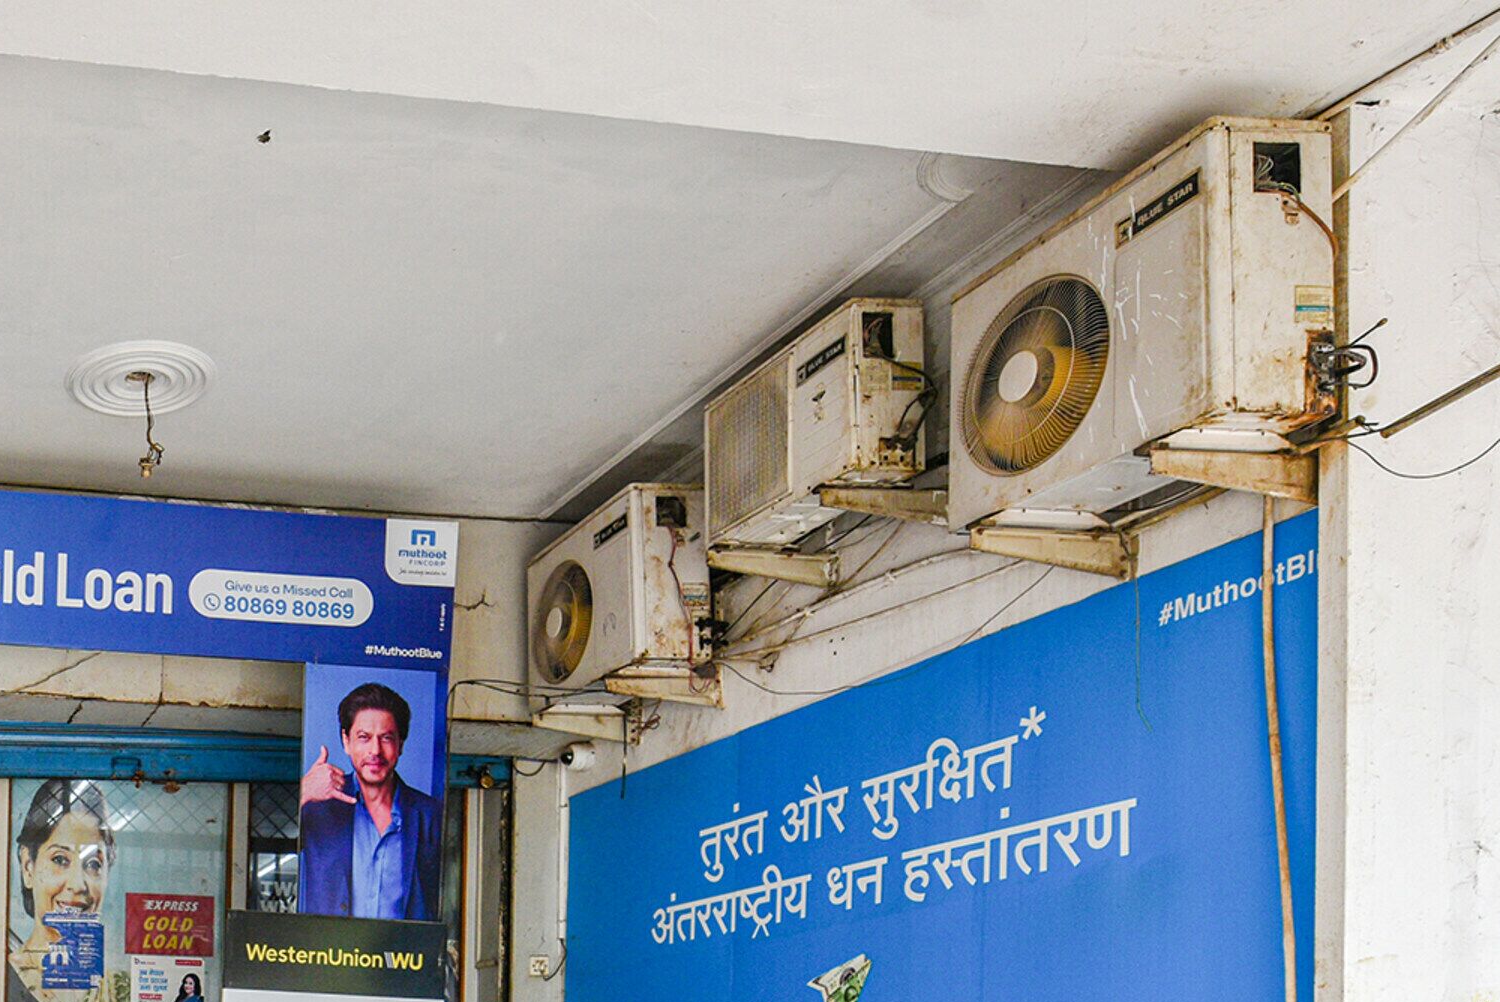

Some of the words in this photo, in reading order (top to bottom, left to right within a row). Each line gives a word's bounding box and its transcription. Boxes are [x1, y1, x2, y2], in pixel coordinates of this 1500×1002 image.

[1167, 183, 1193, 206] STAR
[398, 549, 447, 559] muthoot
[56, 553, 173, 615] Loan
[224, 579, 252, 592] Give
[255, 584, 269, 593] us
[272, 585, 281, 595] a
[283, 584, 327, 598] Missed
[330, 586, 353, 599] Call
[1158, 549, 1319, 627] #MuthotBl
[224, 596, 287, 615] 80869
[293, 601, 354, 619] 80869
[364, 645, 442, 660] #MuthootBlue
[699, 802, 768, 883] तुरंत
[779, 774, 849, 843] और
[651, 864, 812, 946] अंतरराष्ट्रीय
[826, 856, 888, 911] धन
[902, 798, 1138, 902] हस्तांतरण
[143, 899, 199, 912] EXPRESS
[143, 916, 194, 932] GOLD
[143, 934, 194, 950] LOAN
[246, 942, 383, 969] WesternUnion
